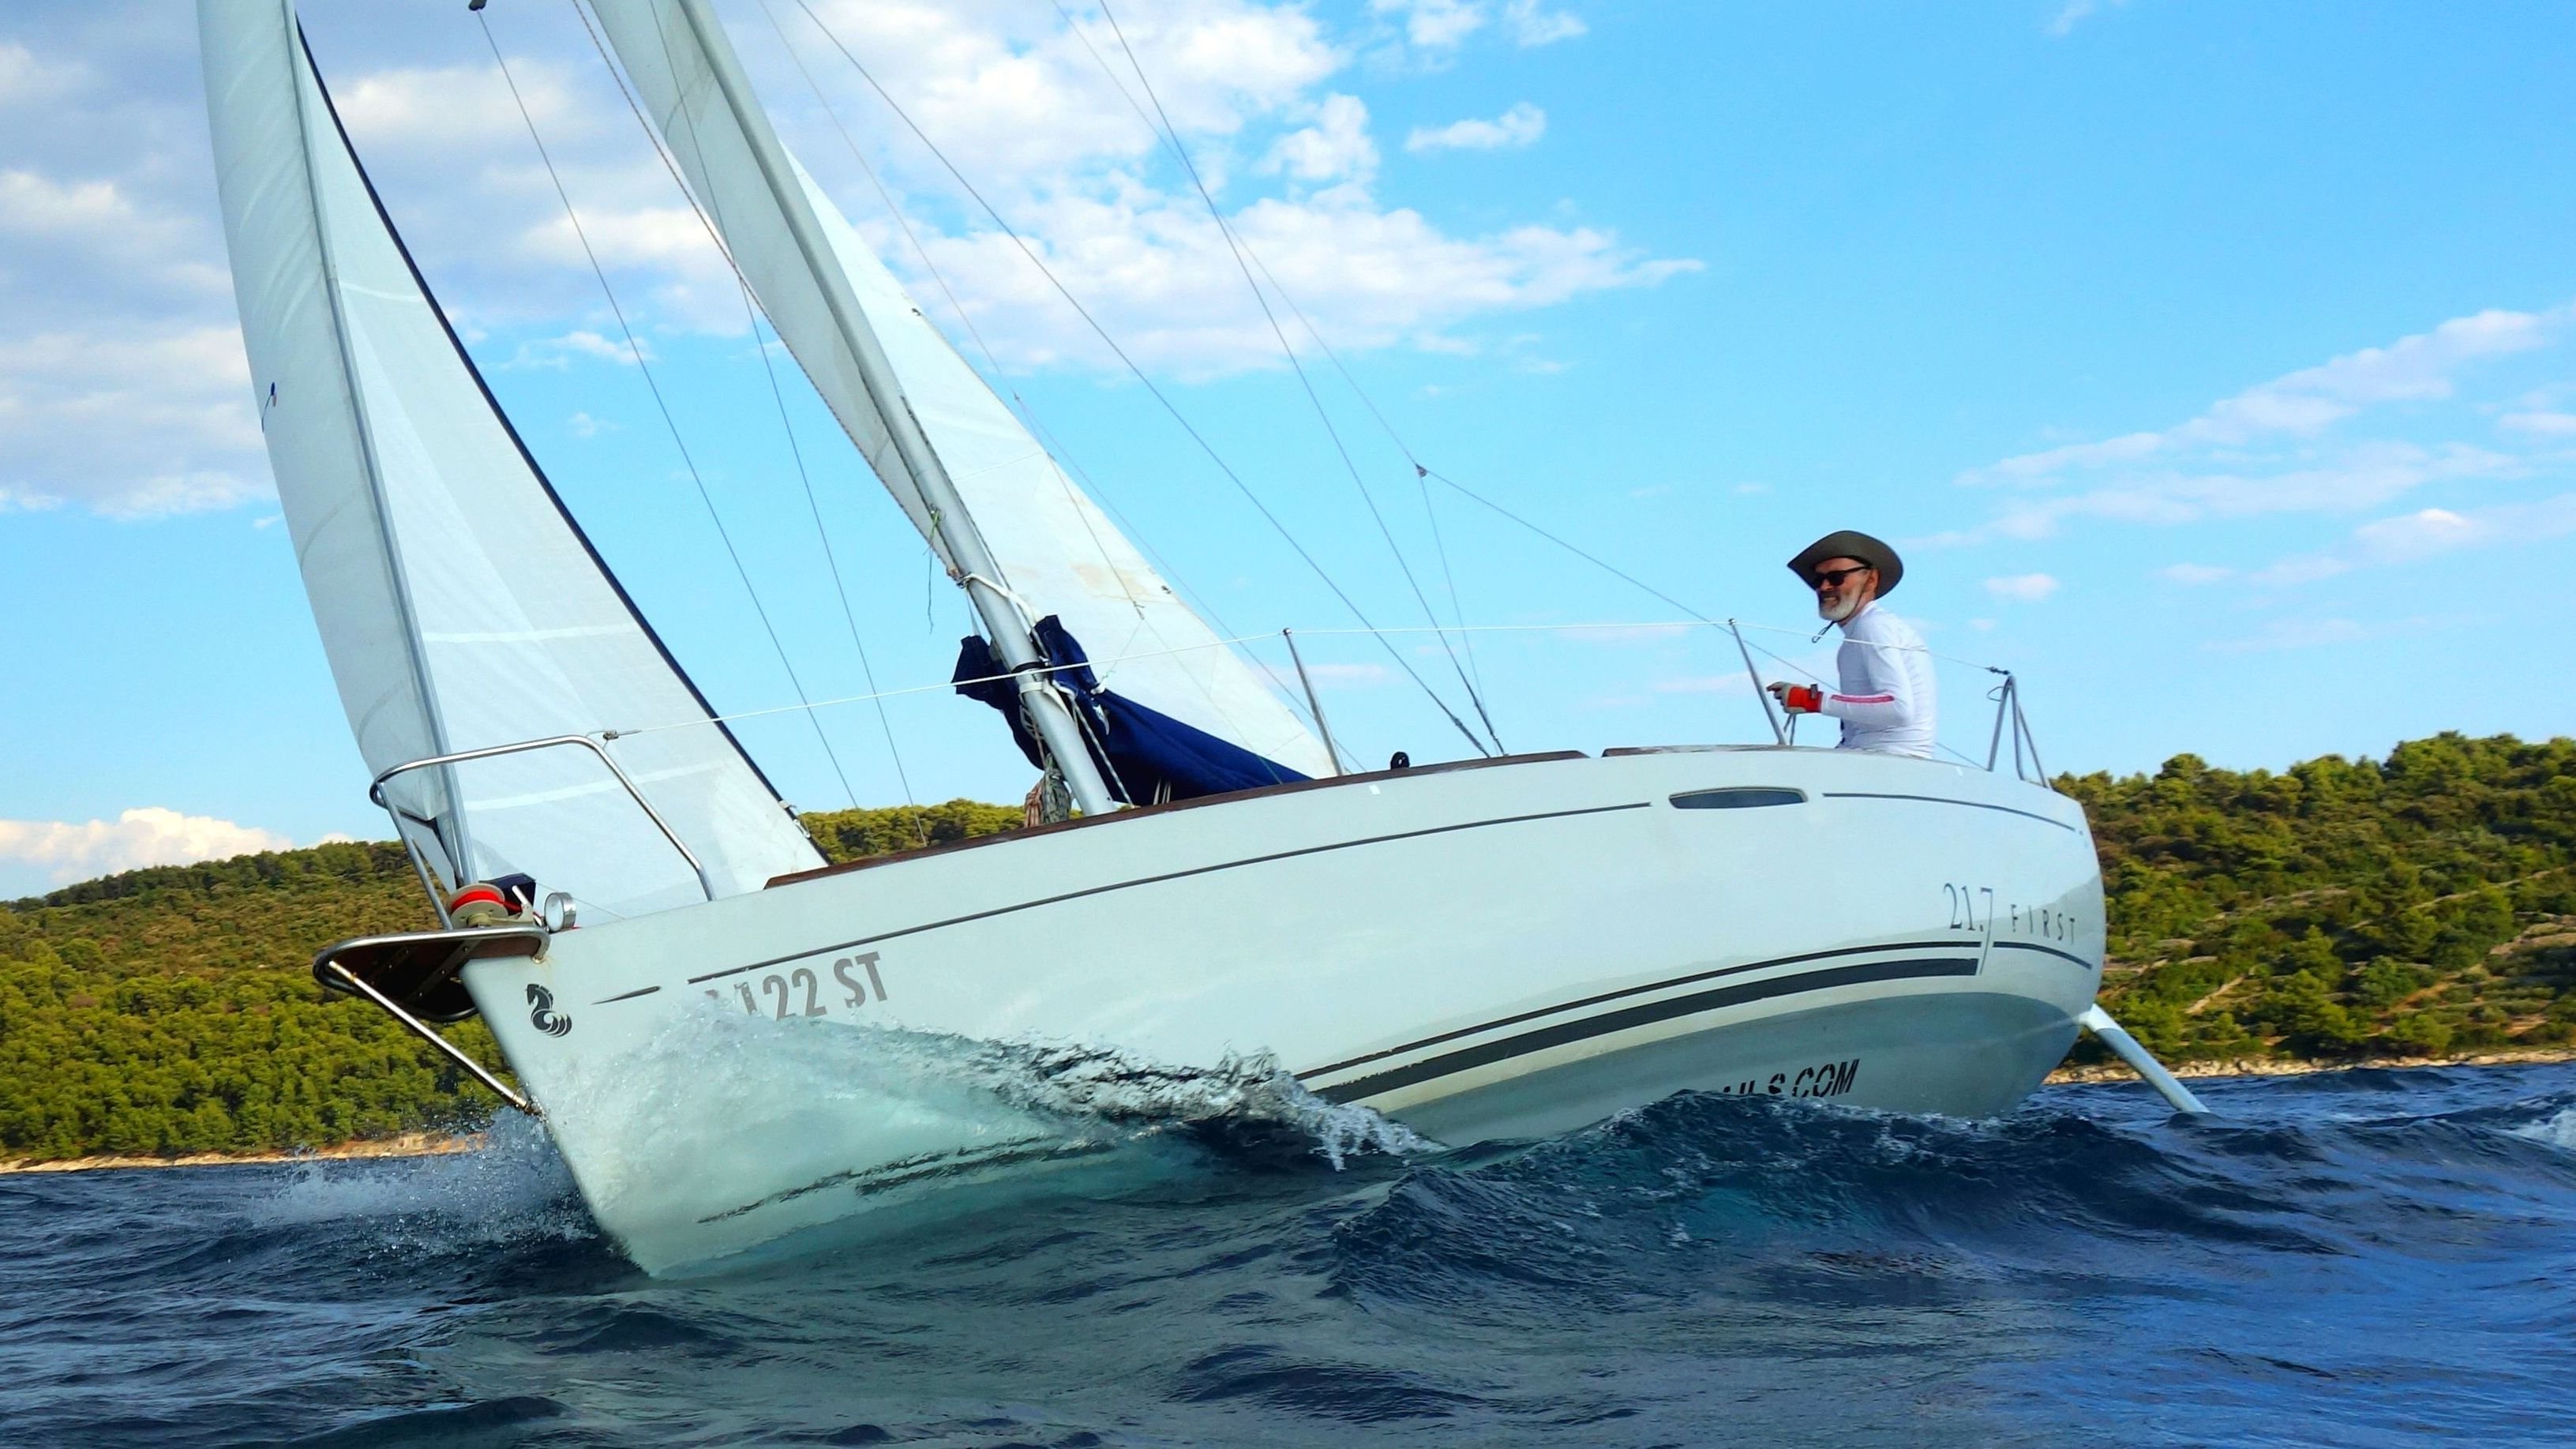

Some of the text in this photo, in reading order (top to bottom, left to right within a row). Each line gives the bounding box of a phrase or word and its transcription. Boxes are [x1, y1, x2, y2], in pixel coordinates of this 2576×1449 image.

[1944, 882, 2075, 975] 21.7 FIRST
[705, 951, 888, 1022] 122 ST
